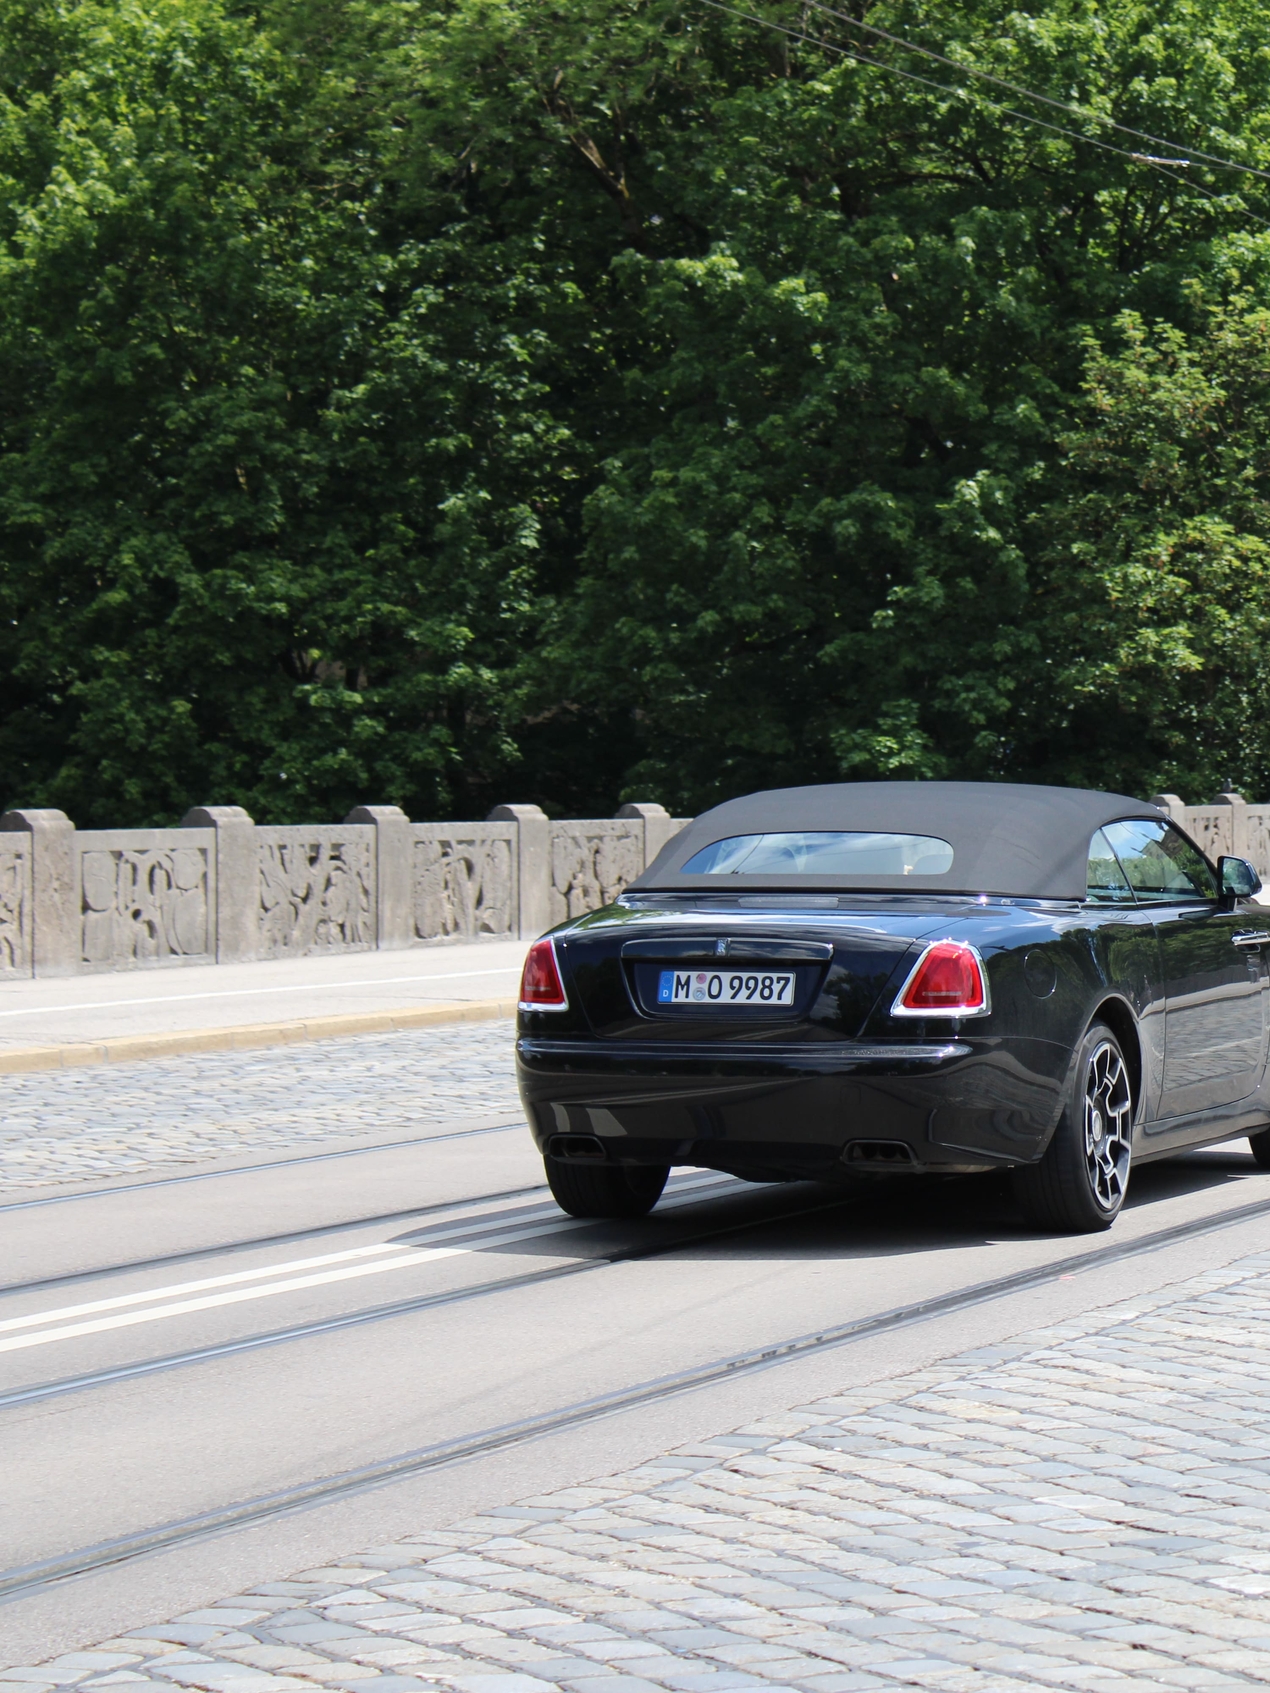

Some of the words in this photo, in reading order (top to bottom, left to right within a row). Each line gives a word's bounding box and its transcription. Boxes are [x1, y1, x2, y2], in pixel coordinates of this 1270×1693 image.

[662, 989, 669, 998] D
[674, 975, 691, 999] M
[729, 976, 791, 1000] 9987
